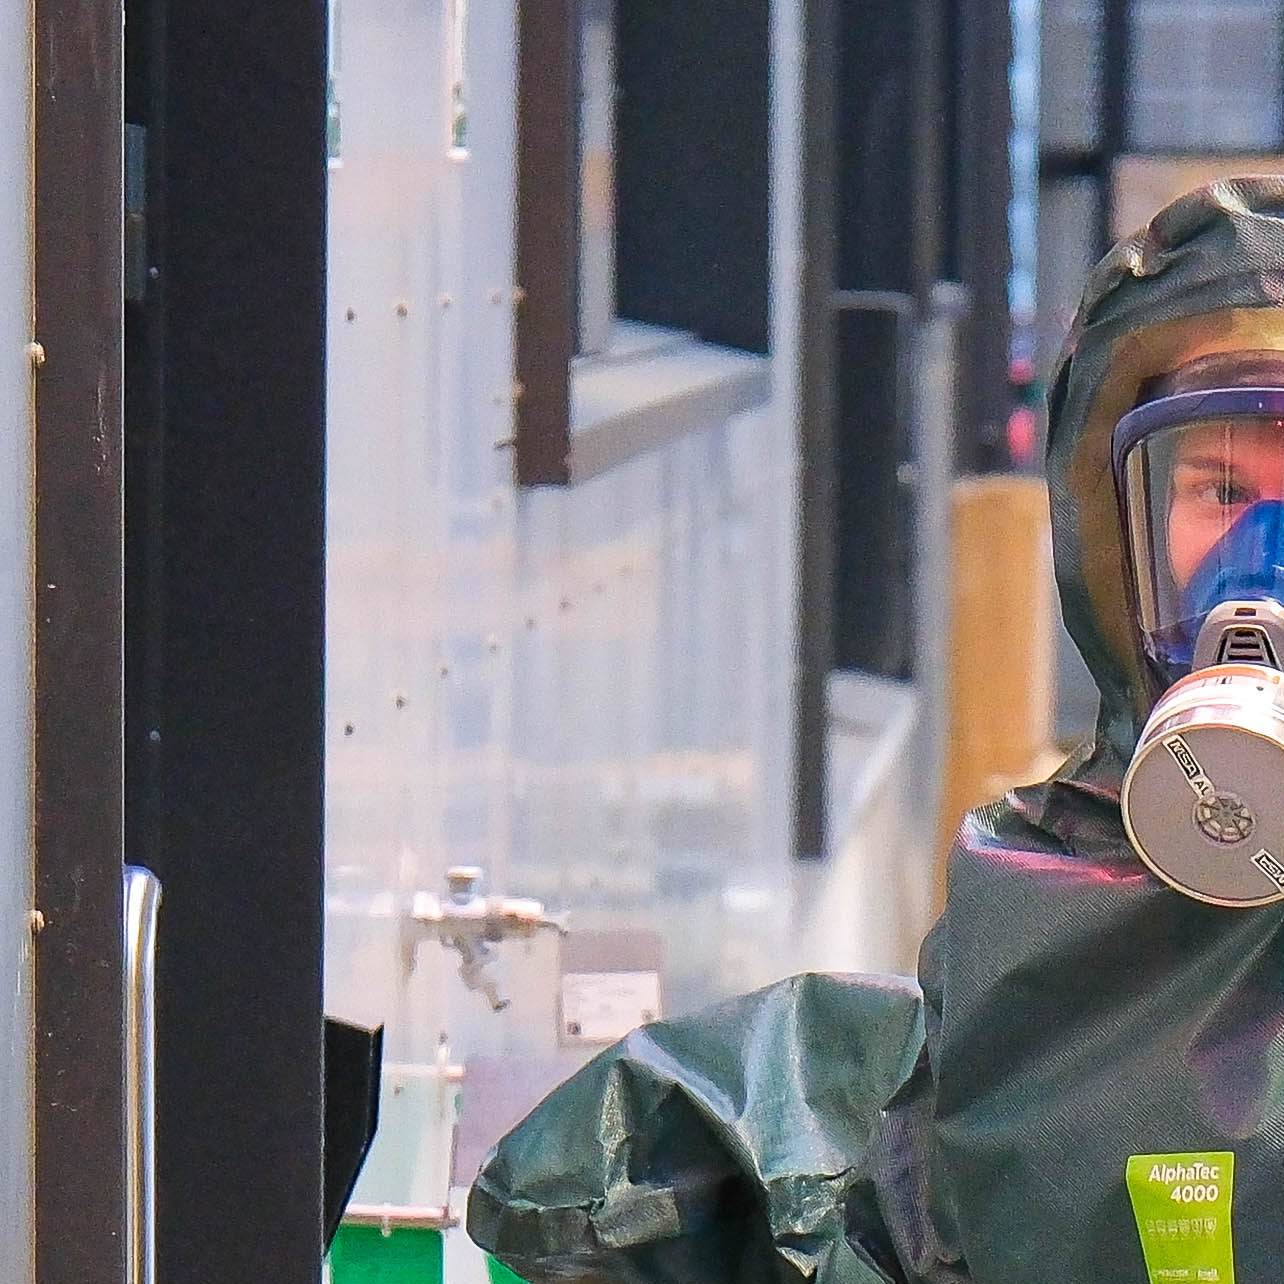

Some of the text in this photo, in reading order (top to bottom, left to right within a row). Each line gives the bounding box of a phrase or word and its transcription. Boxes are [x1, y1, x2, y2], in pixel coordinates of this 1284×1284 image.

[1169, 740, 1198, 777] MSA
[1148, 1162, 1220, 1185] AlphaTec
[1170, 1184, 1219, 1203] 4000
